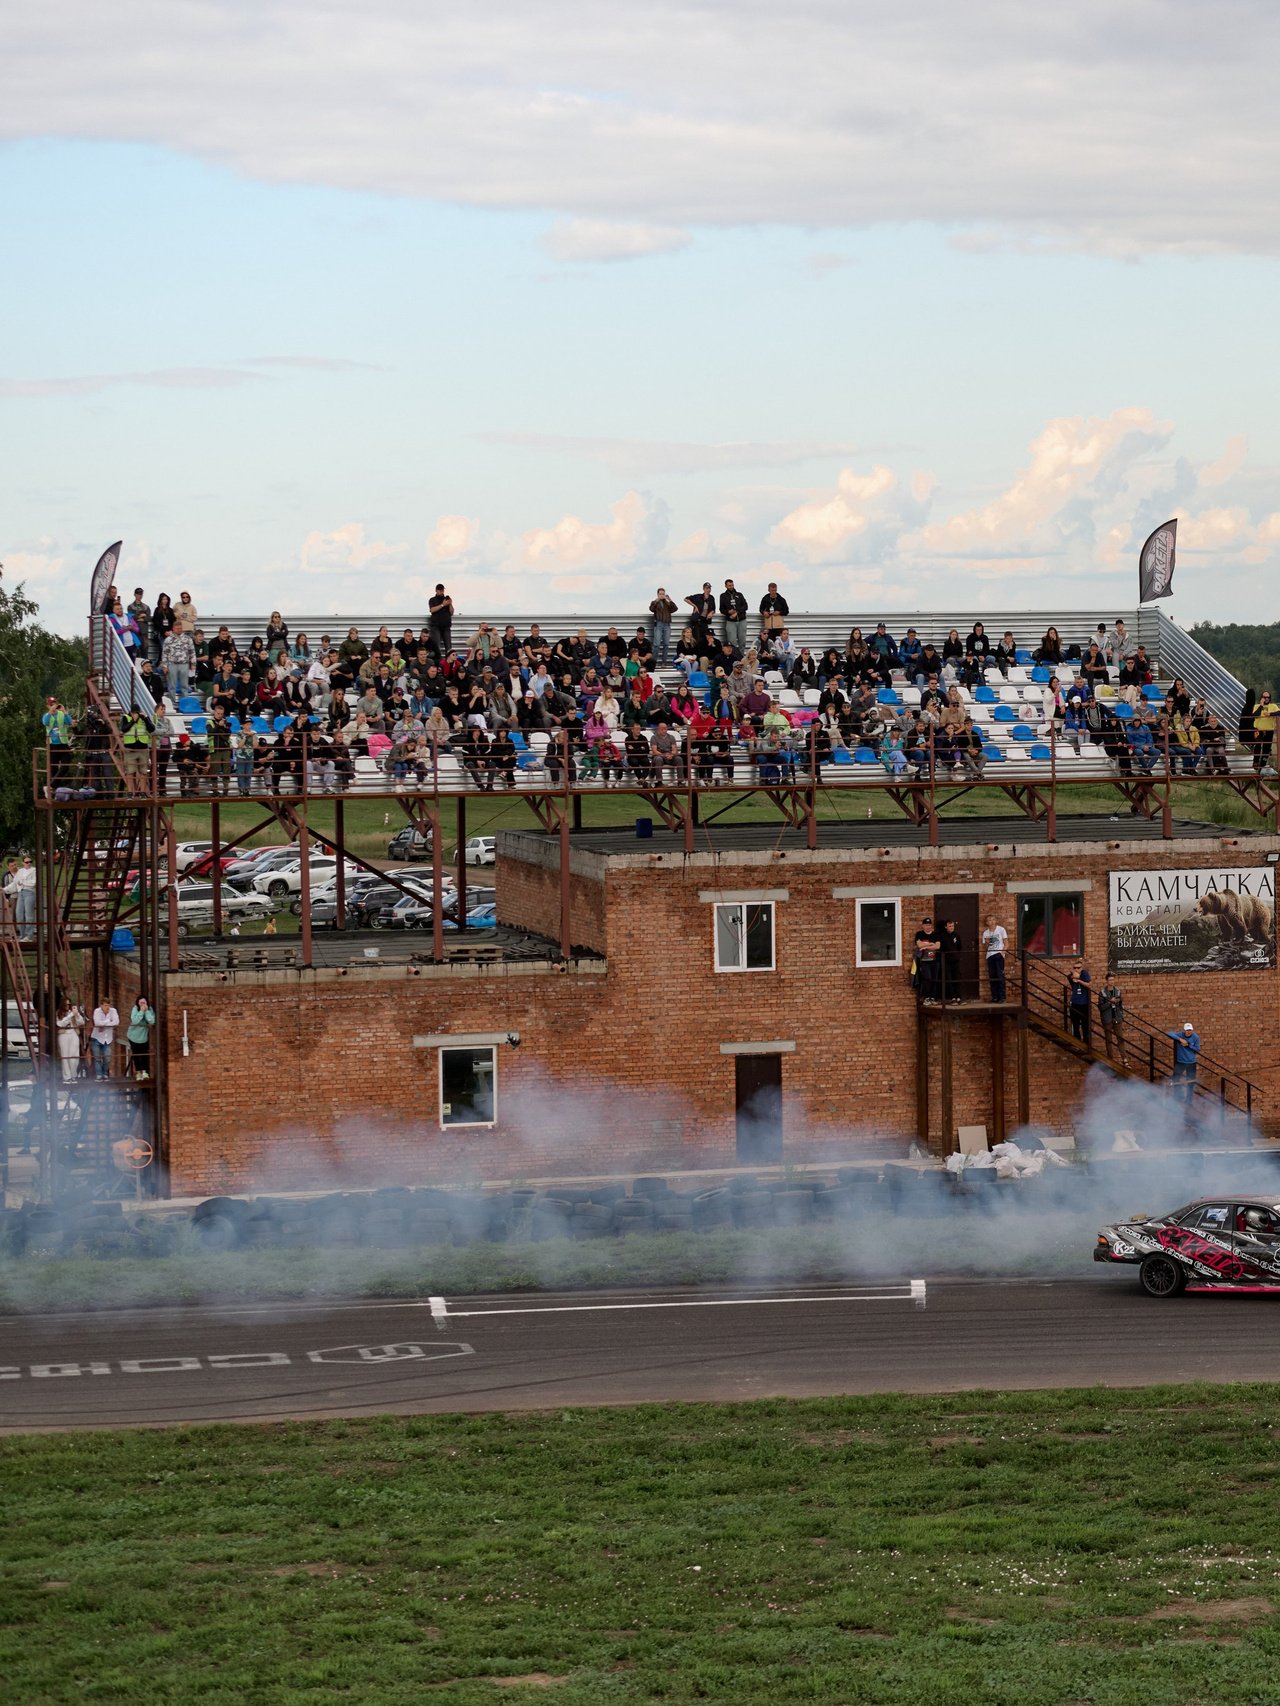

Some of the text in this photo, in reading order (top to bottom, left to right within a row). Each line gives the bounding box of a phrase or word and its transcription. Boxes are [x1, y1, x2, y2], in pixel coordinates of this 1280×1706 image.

[1117, 873, 1274, 902] КАМЧАТКА
[1116, 904, 1181, 916] КВАРТАЛ
[1117, 923, 1181, 937] БЛИЖЕ, ЧЕМ
[1117, 935, 1187, 948] ВЫ ДУМАЕТЕ!
[0, 1351, 292, 1380] СОЮ
